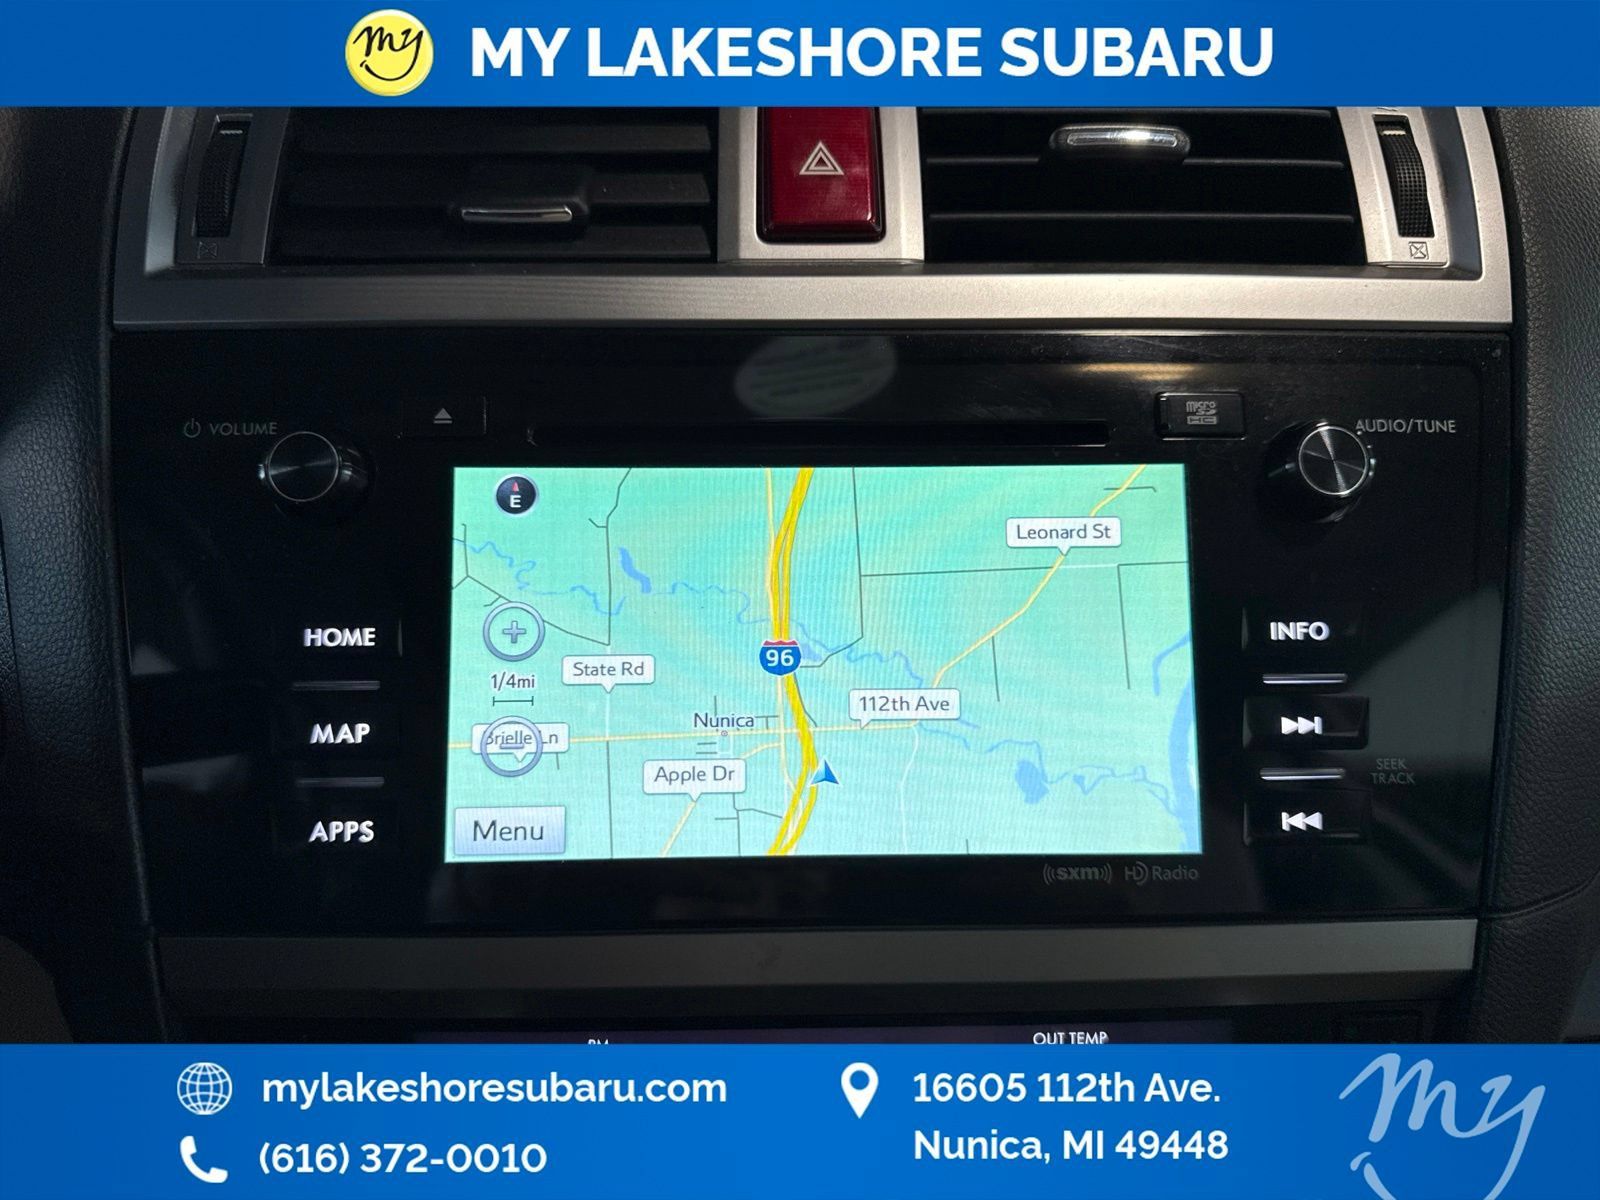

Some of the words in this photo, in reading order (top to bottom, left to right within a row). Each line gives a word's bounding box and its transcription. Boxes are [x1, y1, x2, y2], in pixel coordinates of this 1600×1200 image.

[209, 422, 277, 436] VOLUME
[1355, 419, 1456, 434] AUDIO/TUNE
[509, 494, 522, 507] E
[1017, 524, 1087, 540] Leonard
[1093, 524, 1111, 540] St
[303, 627, 376, 648] HOME
[1269, 621, 1330, 641] INFO
[765, 648, 795, 668] 96
[573, 661, 617, 677] State
[621, 661, 644, 676] Rd
[859, 696, 909, 712] 112th
[915, 696, 950, 712] Ave
[694, 711, 754, 728] Nunica
[309, 722, 371, 744] MAP
[1376, 758, 1408, 770] SEEK
[654, 766, 706, 786] Apple
[713, 766, 735, 783] Dr
[1369, 771, 1416, 785] TRACK
[309, 820, 375, 843] APPS
[472, 820, 544, 842] Menu
[1152, 864, 1199, 880] Radio
[1033, 1032, 1066, 1044] OUT
[1069, 1031, 1109, 1044] TEMP
